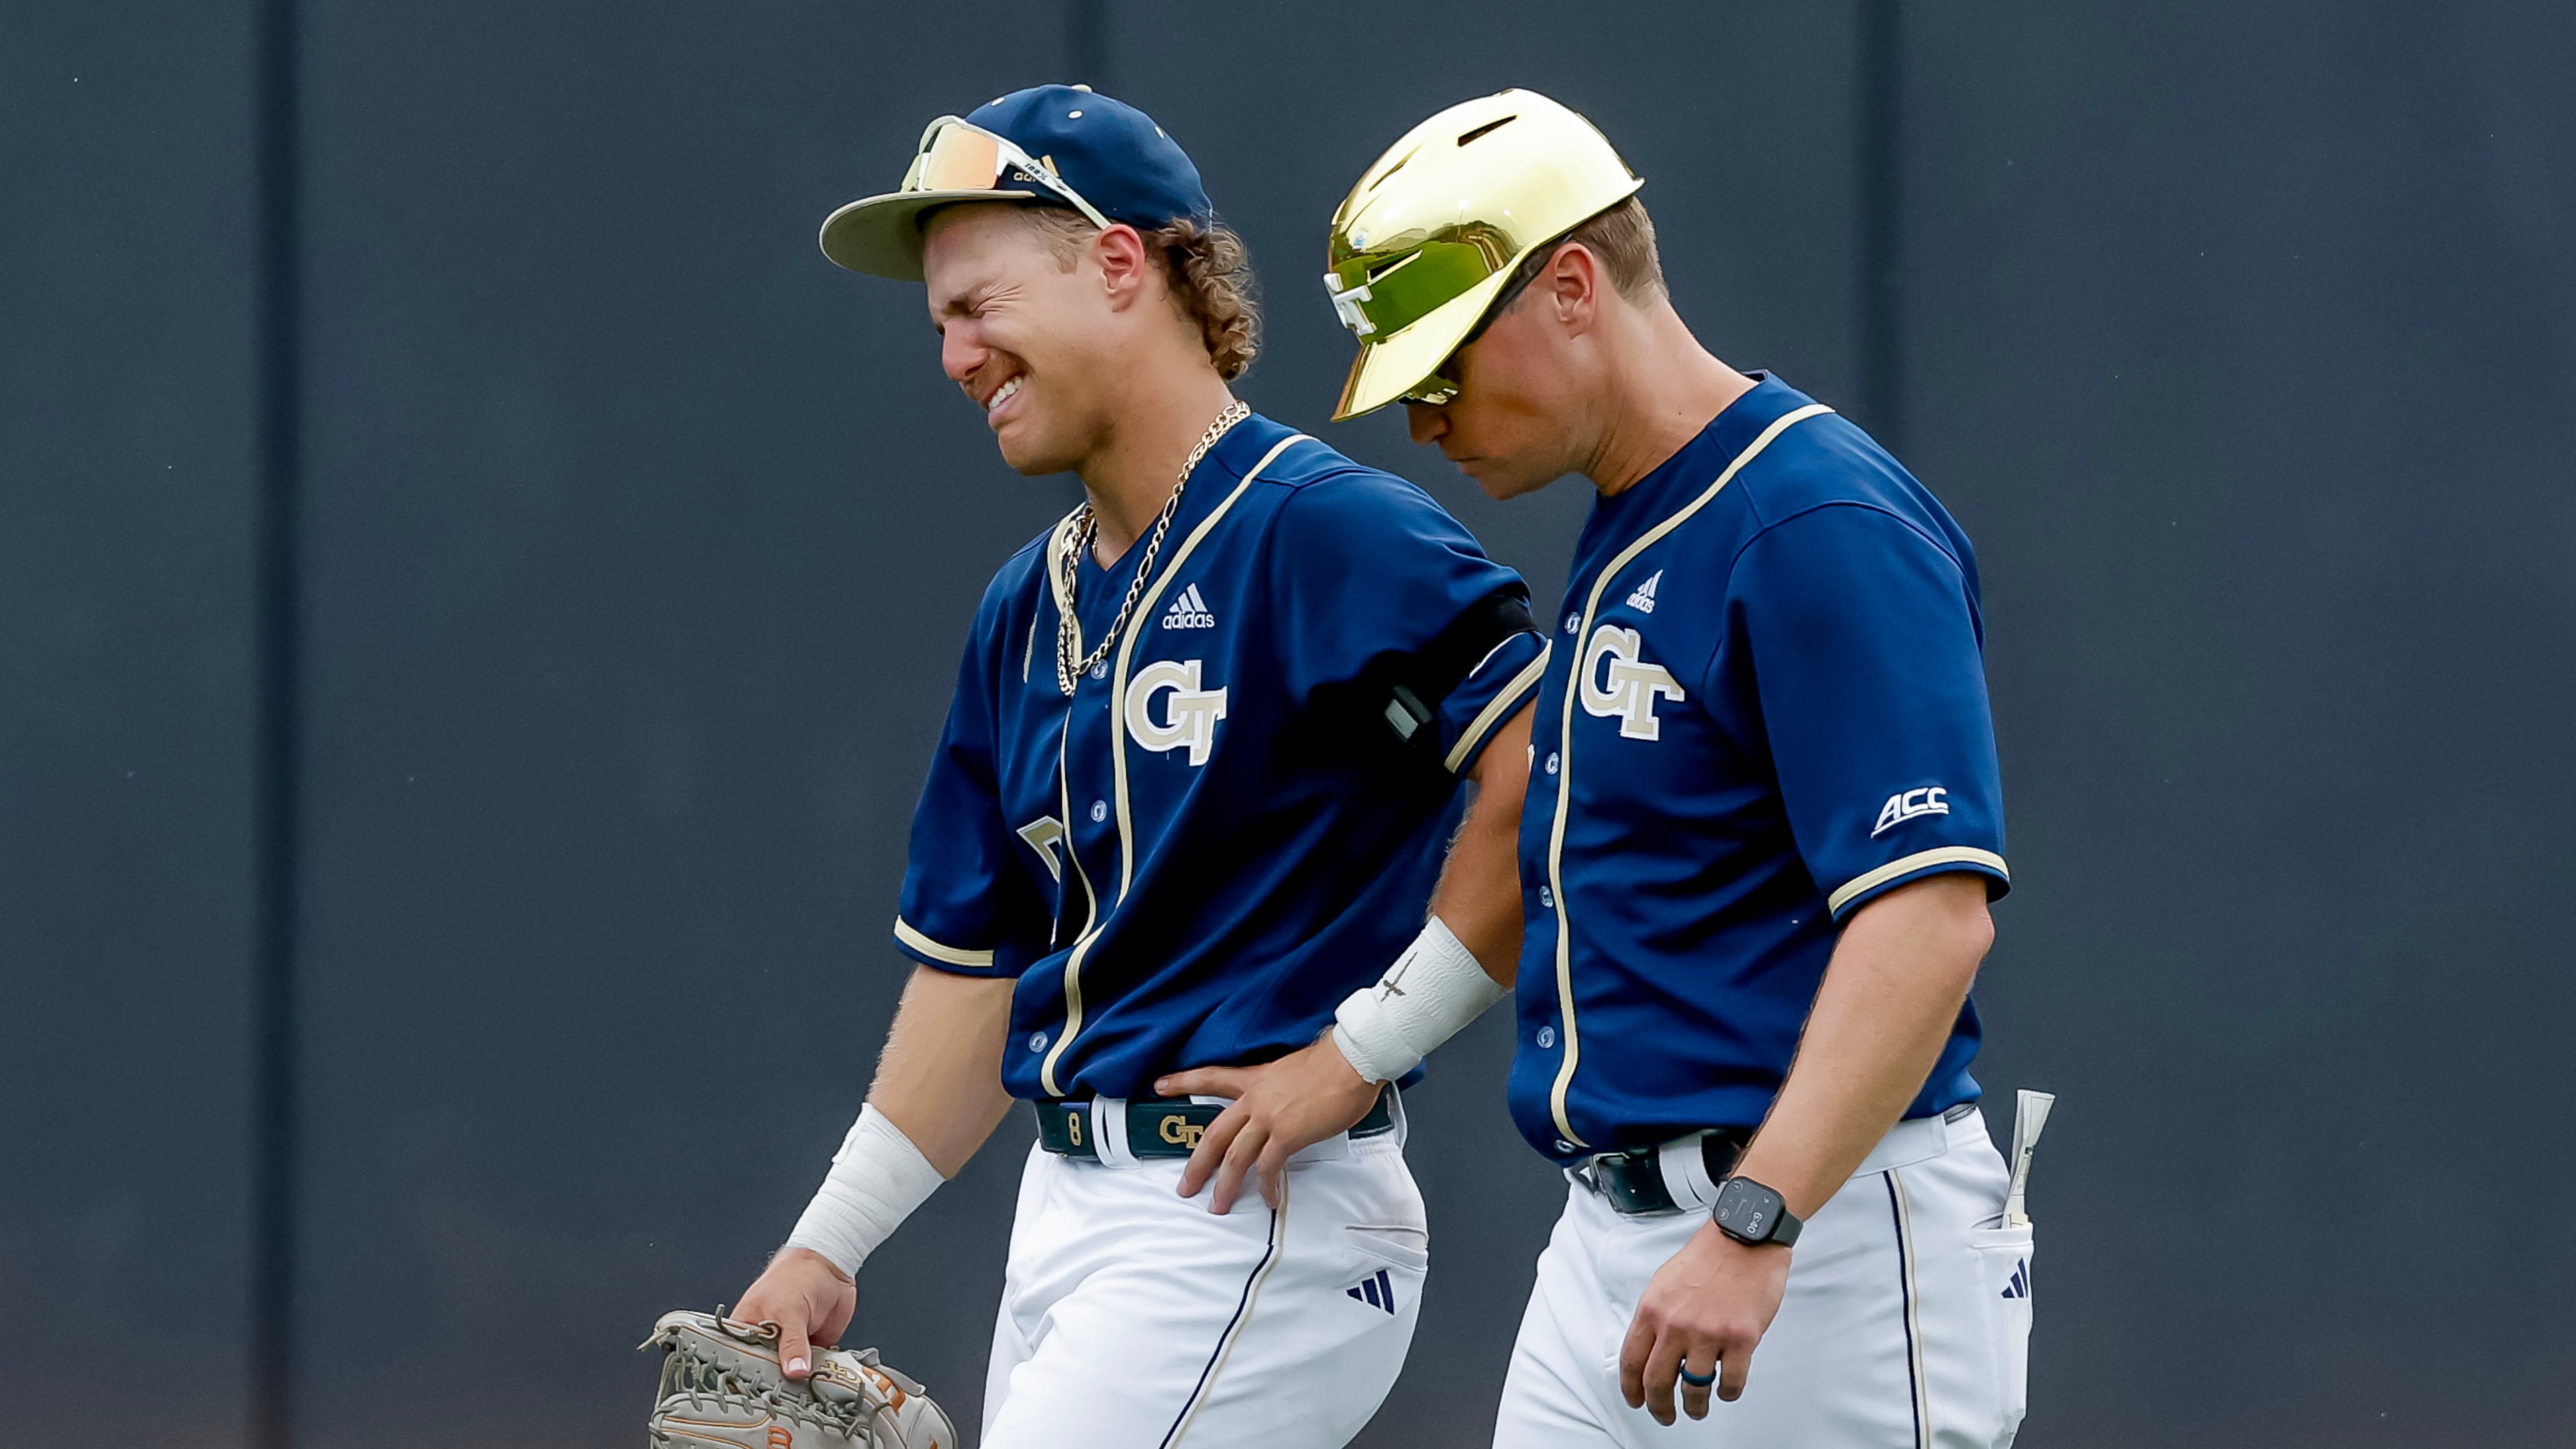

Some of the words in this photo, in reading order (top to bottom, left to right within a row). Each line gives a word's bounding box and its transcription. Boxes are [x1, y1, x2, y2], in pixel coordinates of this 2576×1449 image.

[1025, 163, 1048, 180] 100%
[1162, 610, 1215, 629] adidas
[1580, 625, 1685, 741] GT
[1124, 659, 1227, 766] GT
[1874, 786, 1949, 831] ACC
[1068, 1112, 1082, 1146] 8
[1159, 1115, 1203, 1149] GT
[1746, 1212, 1763, 1234] 6:40
